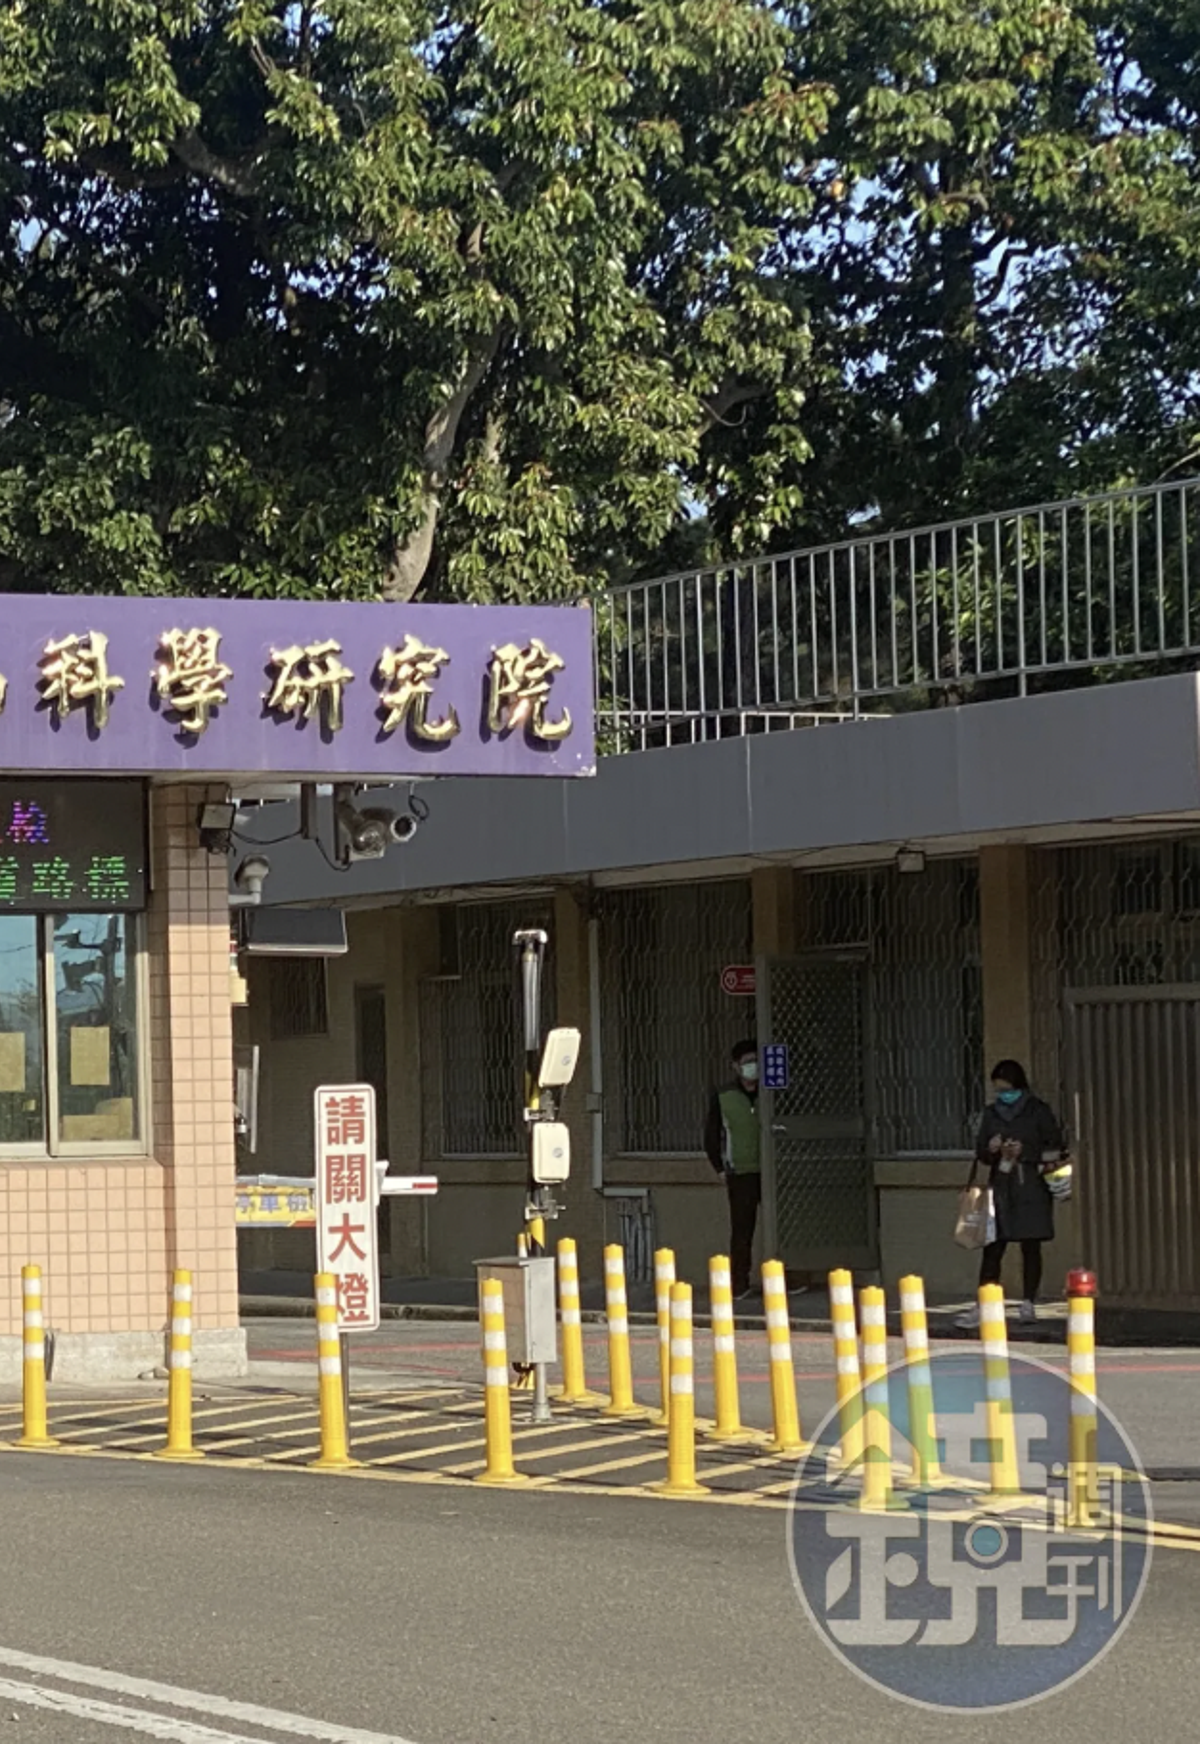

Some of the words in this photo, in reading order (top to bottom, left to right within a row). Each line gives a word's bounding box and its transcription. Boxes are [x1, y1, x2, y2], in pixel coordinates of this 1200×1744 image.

[236, 1190, 315, 1214] 停車檢
[325, 1096, 370, 1322] 請關大燈
